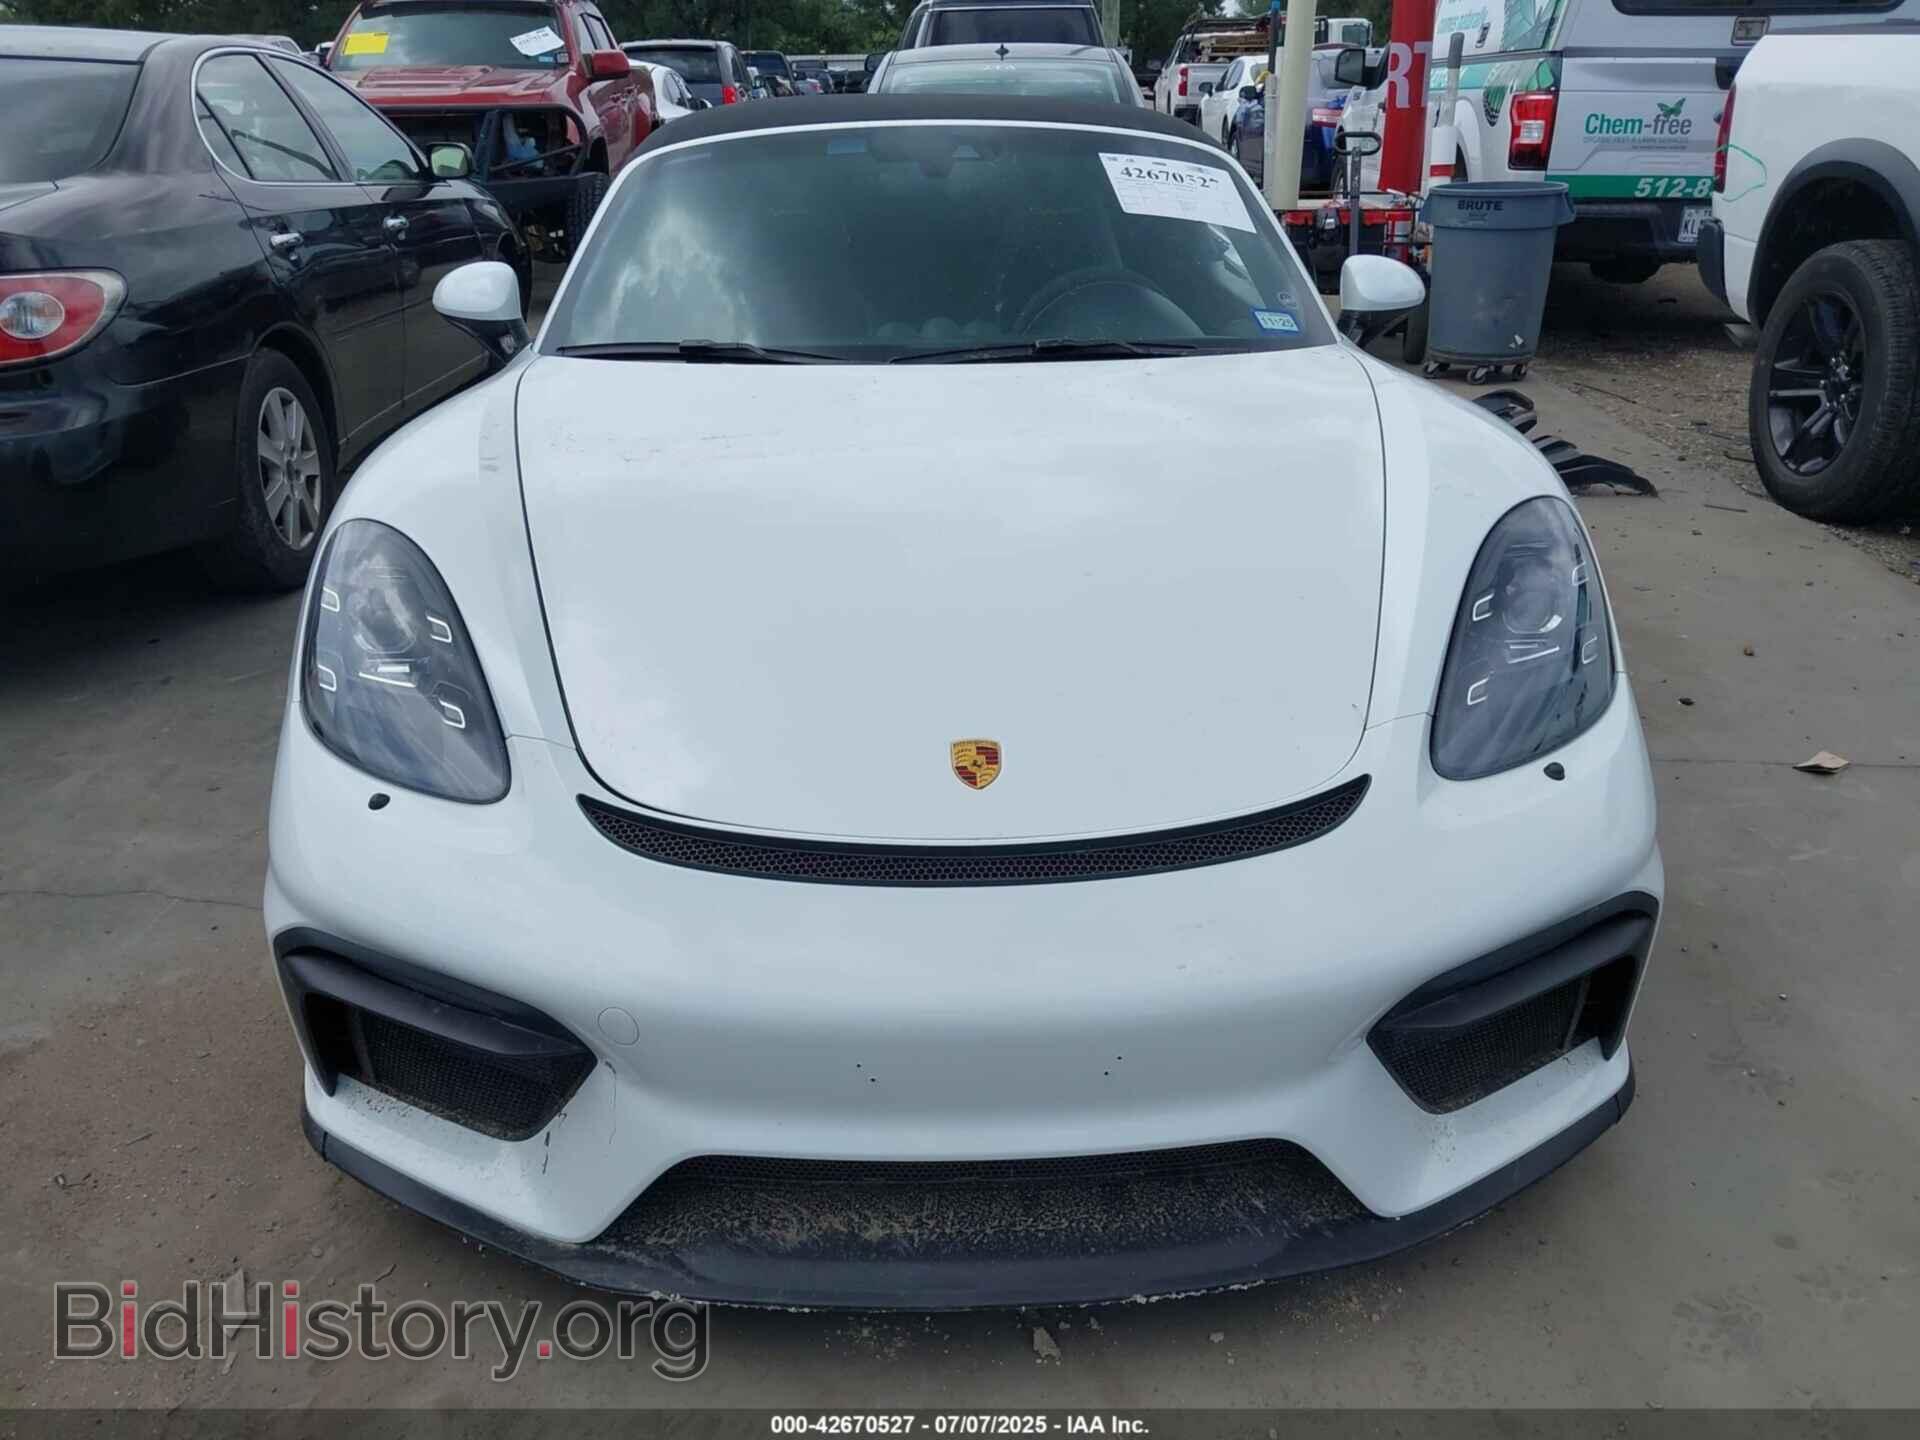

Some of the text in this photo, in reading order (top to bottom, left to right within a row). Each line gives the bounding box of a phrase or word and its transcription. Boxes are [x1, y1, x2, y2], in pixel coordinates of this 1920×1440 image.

[1585, 113, 1693, 135] Chem-free
[1634, 177, 1715, 198] 512-8
[1457, 200, 1504, 211] BRUTE
